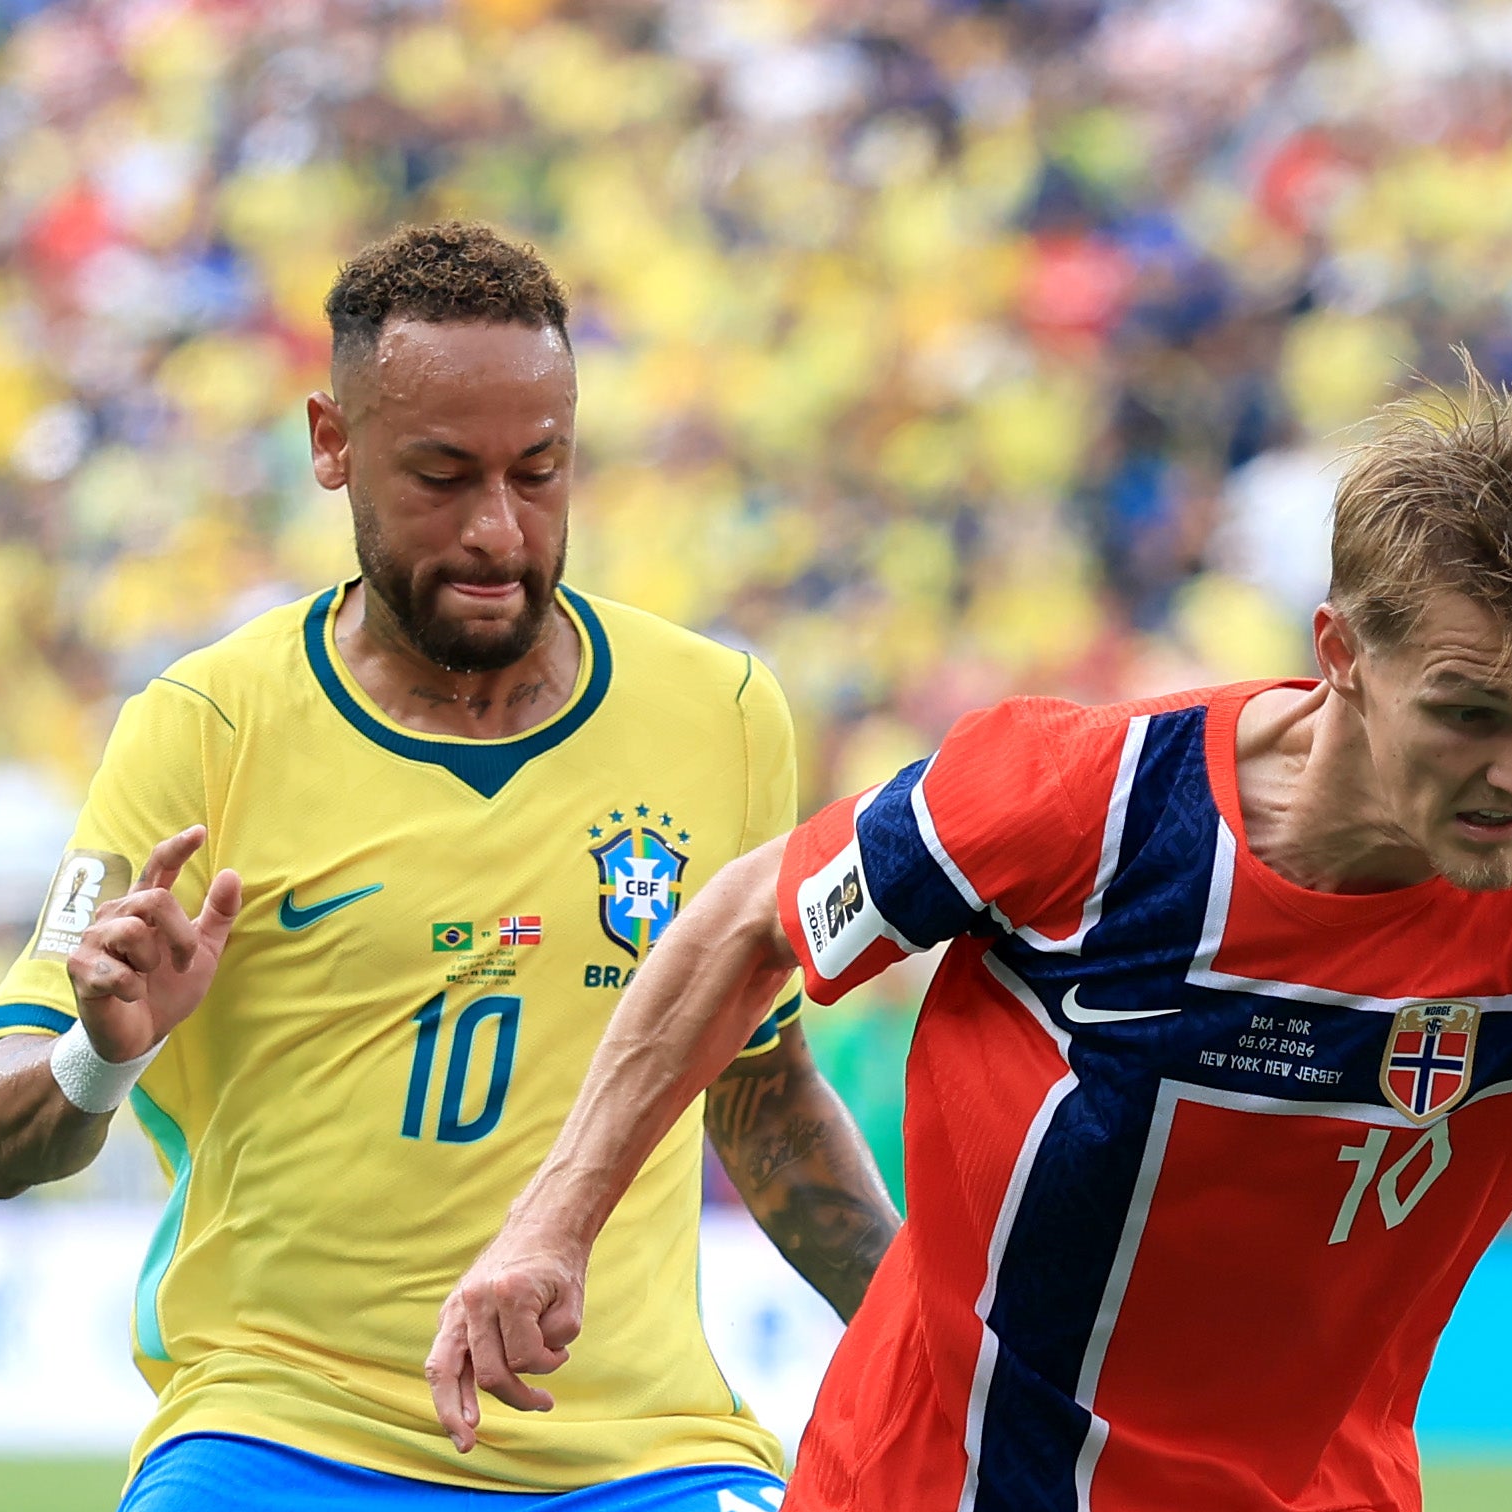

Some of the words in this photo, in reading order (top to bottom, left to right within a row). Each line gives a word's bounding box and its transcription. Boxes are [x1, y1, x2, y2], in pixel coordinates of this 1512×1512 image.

[625, 879, 660, 898] CBF
[807, 904, 824, 954] 2026
[1250, 1014, 1274, 1031] BRA
[1286, 1018, 1312, 1036] NOR
[1423, 1005, 1453, 1017] NORGE
[1238, 1034, 1316, 1059] 05.07.2026
[400, 989, 523, 1146] 10
[1198, 1050, 1228, 1068] NEW
[1230, 1054, 1263, 1073] YORK
[1264, 1059, 1293, 1078] NEW
[1294, 1065, 1344, 1085] JERSEY
[1327, 1117, 1453, 1246] 10
